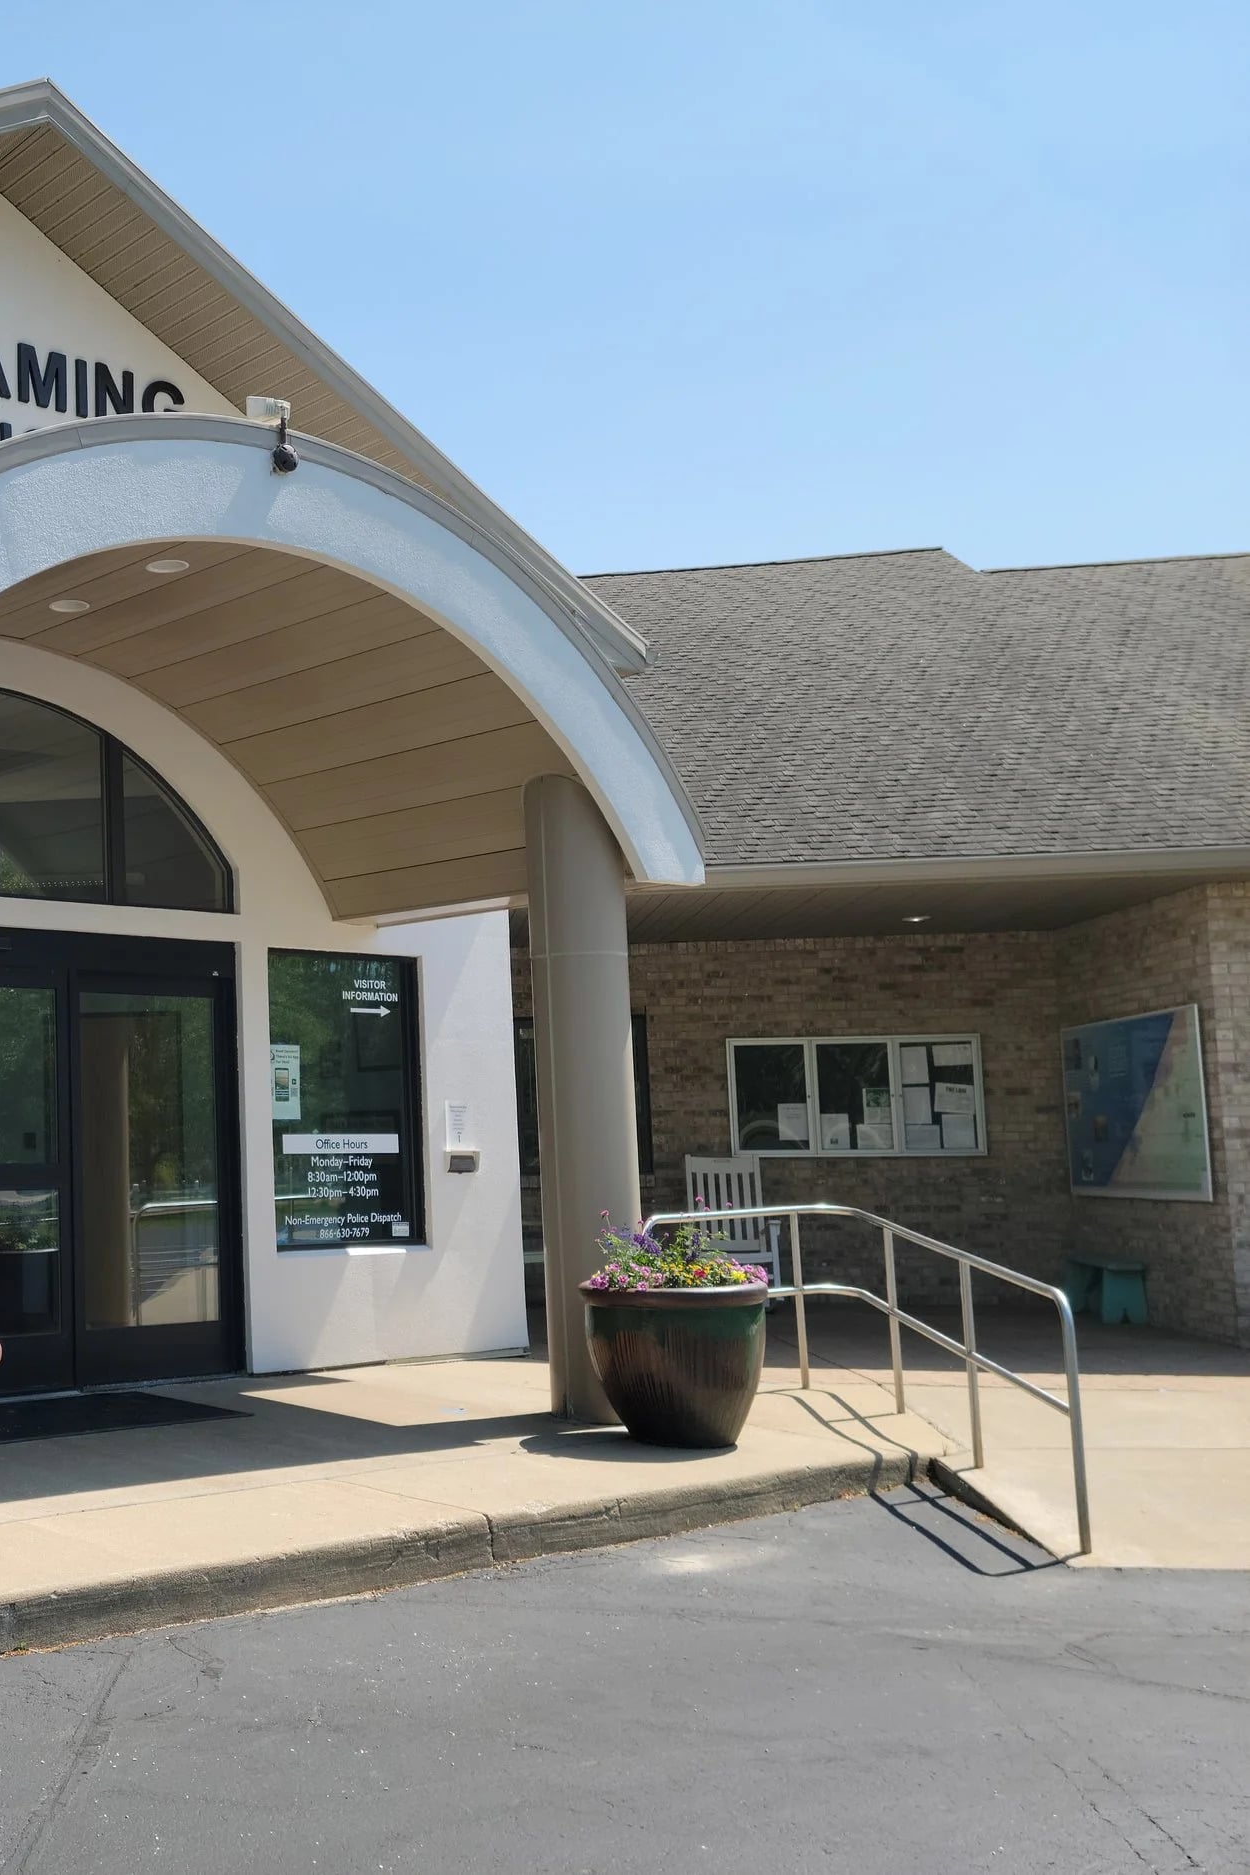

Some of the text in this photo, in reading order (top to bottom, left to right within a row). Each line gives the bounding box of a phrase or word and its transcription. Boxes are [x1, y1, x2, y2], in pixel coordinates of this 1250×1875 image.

[354, 979, 386, 990] VISITOR
[342, 990, 398, 1002] INFORMATION
[315, 1139, 368, 1150] Office Hours
[285, 1212, 402, 1228] Non-Emergency Police Dispatch
[319, 1228, 370, 1239] 866-630-7679
